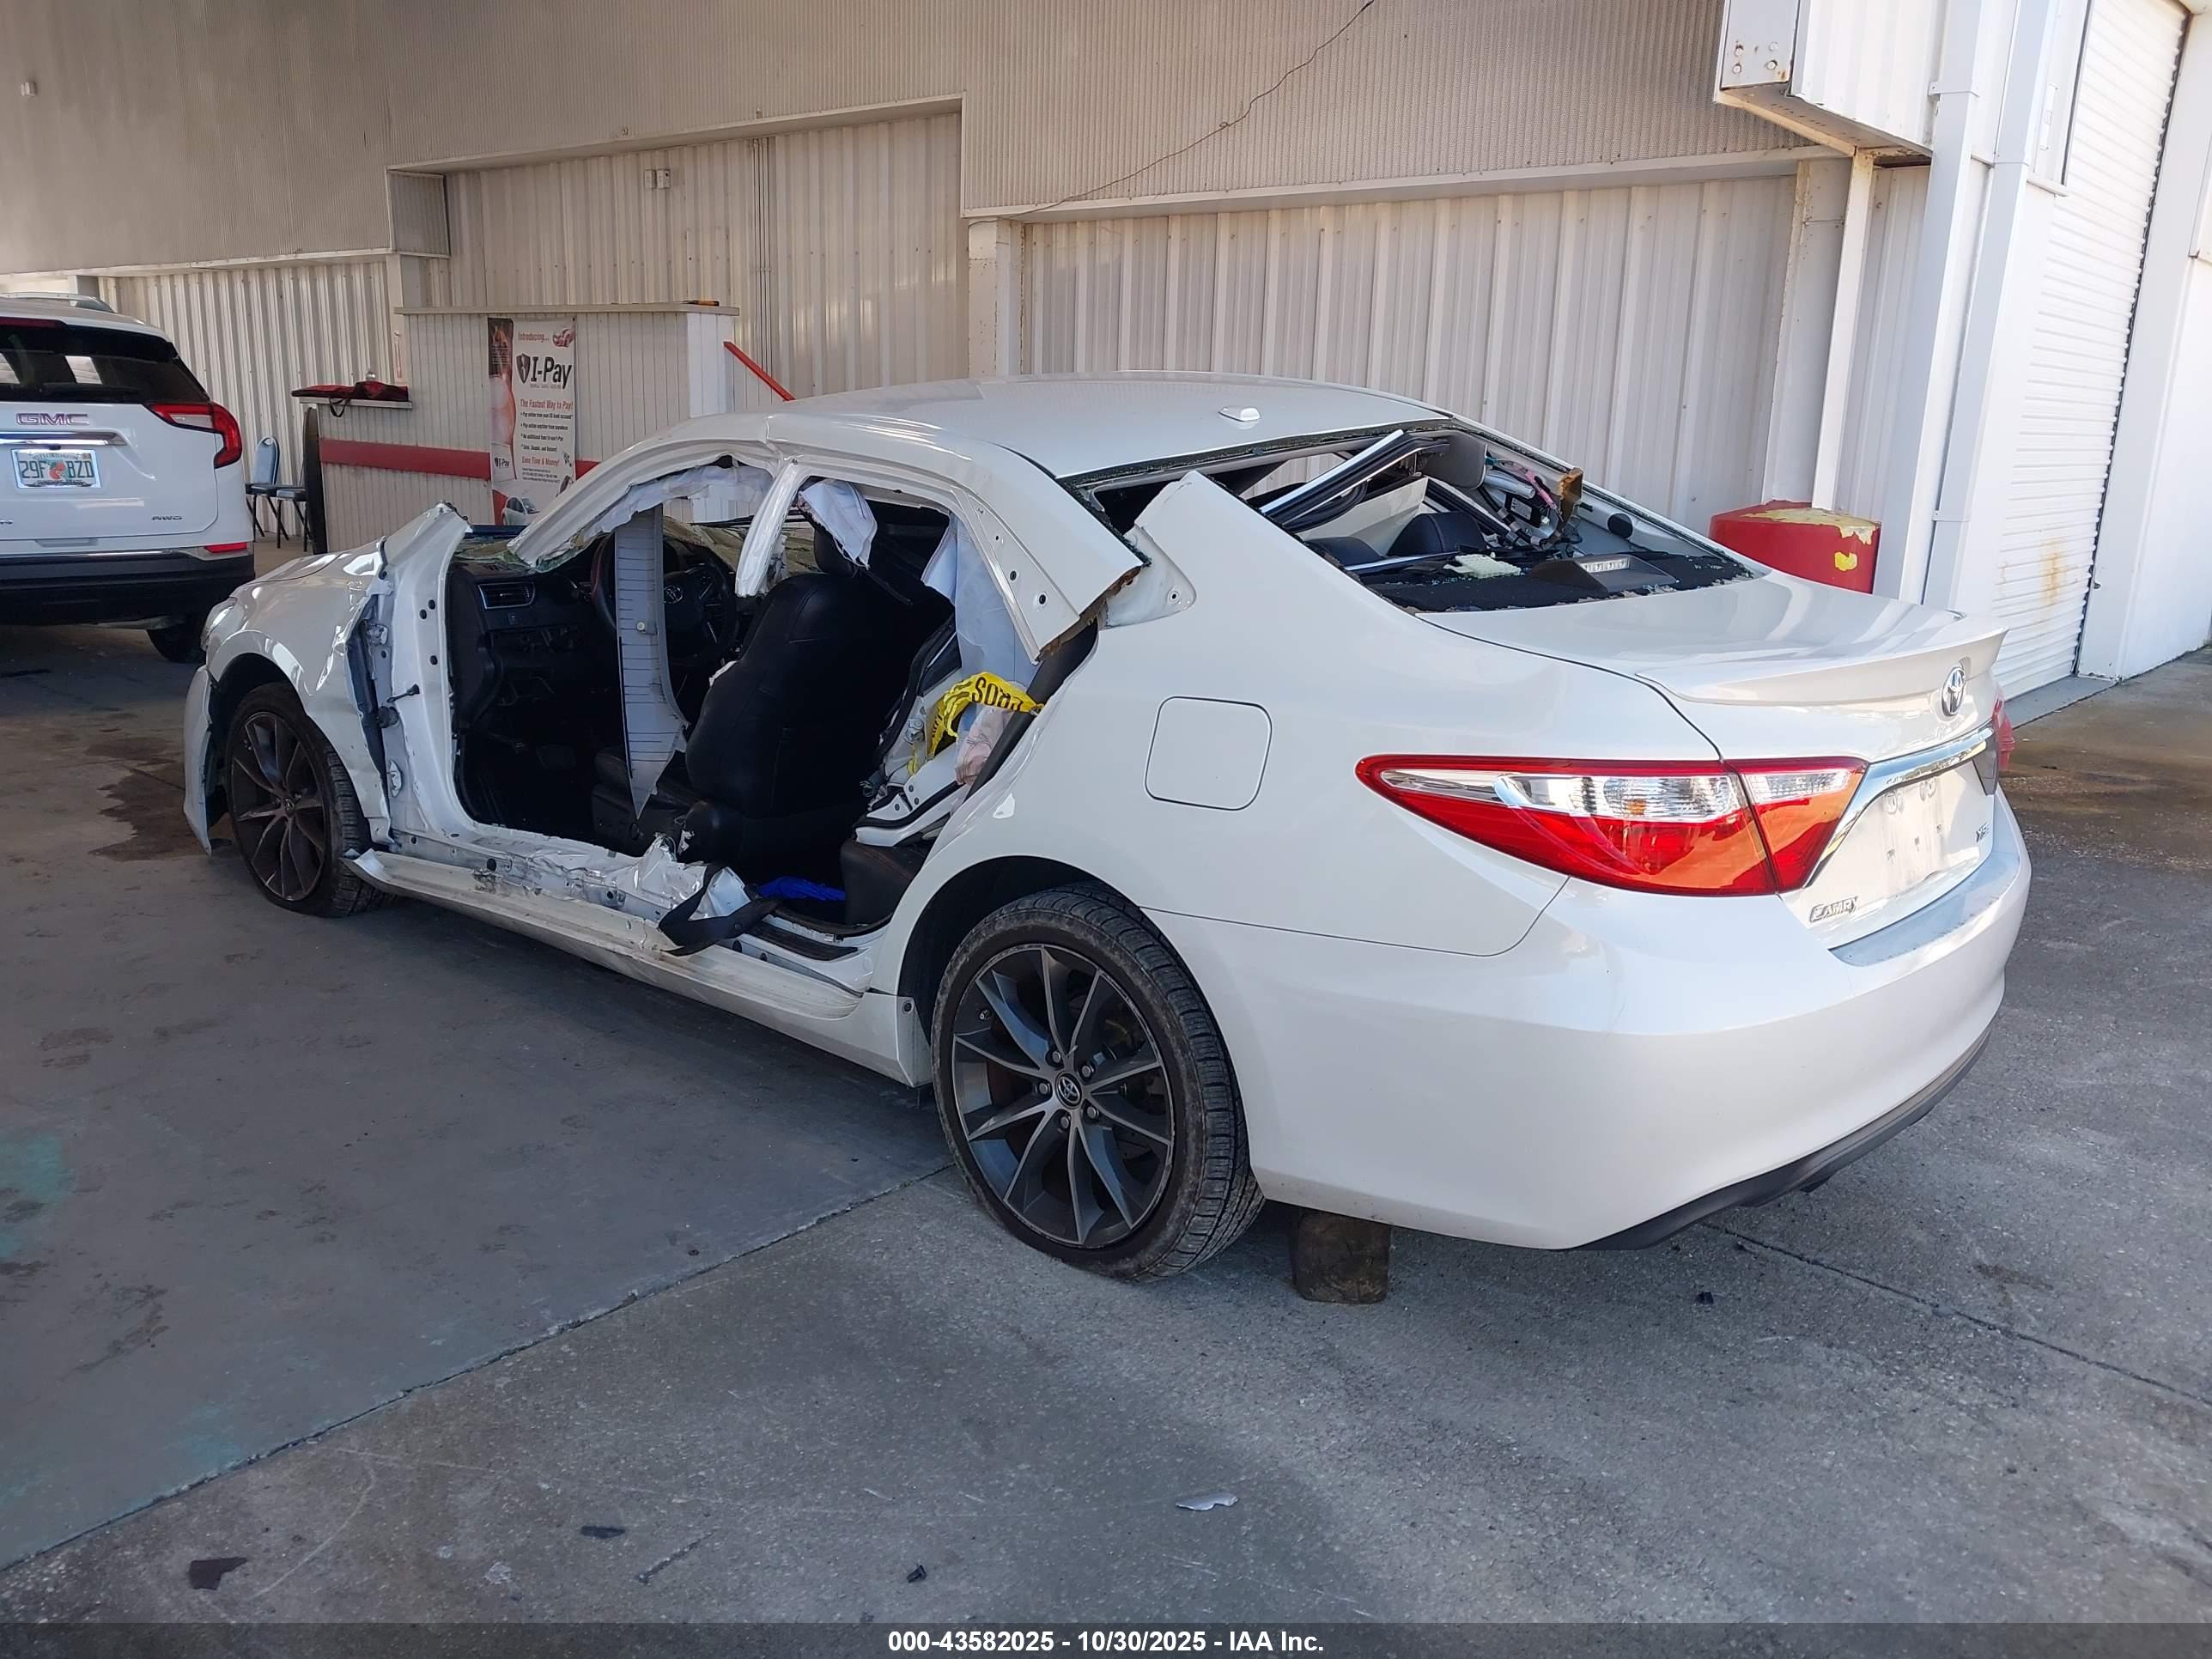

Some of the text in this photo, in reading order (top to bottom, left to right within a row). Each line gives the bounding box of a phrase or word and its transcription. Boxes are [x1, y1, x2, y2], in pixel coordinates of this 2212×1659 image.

[531, 356, 572, 389] I-Pay
[529, 399, 545, 409] Fastest
[546, 399, 556, 410] Way
[16, 413, 89, 425] GMC
[19, 460, 46, 479] 29F
[1809, 896, 1858, 923] CAMRY
